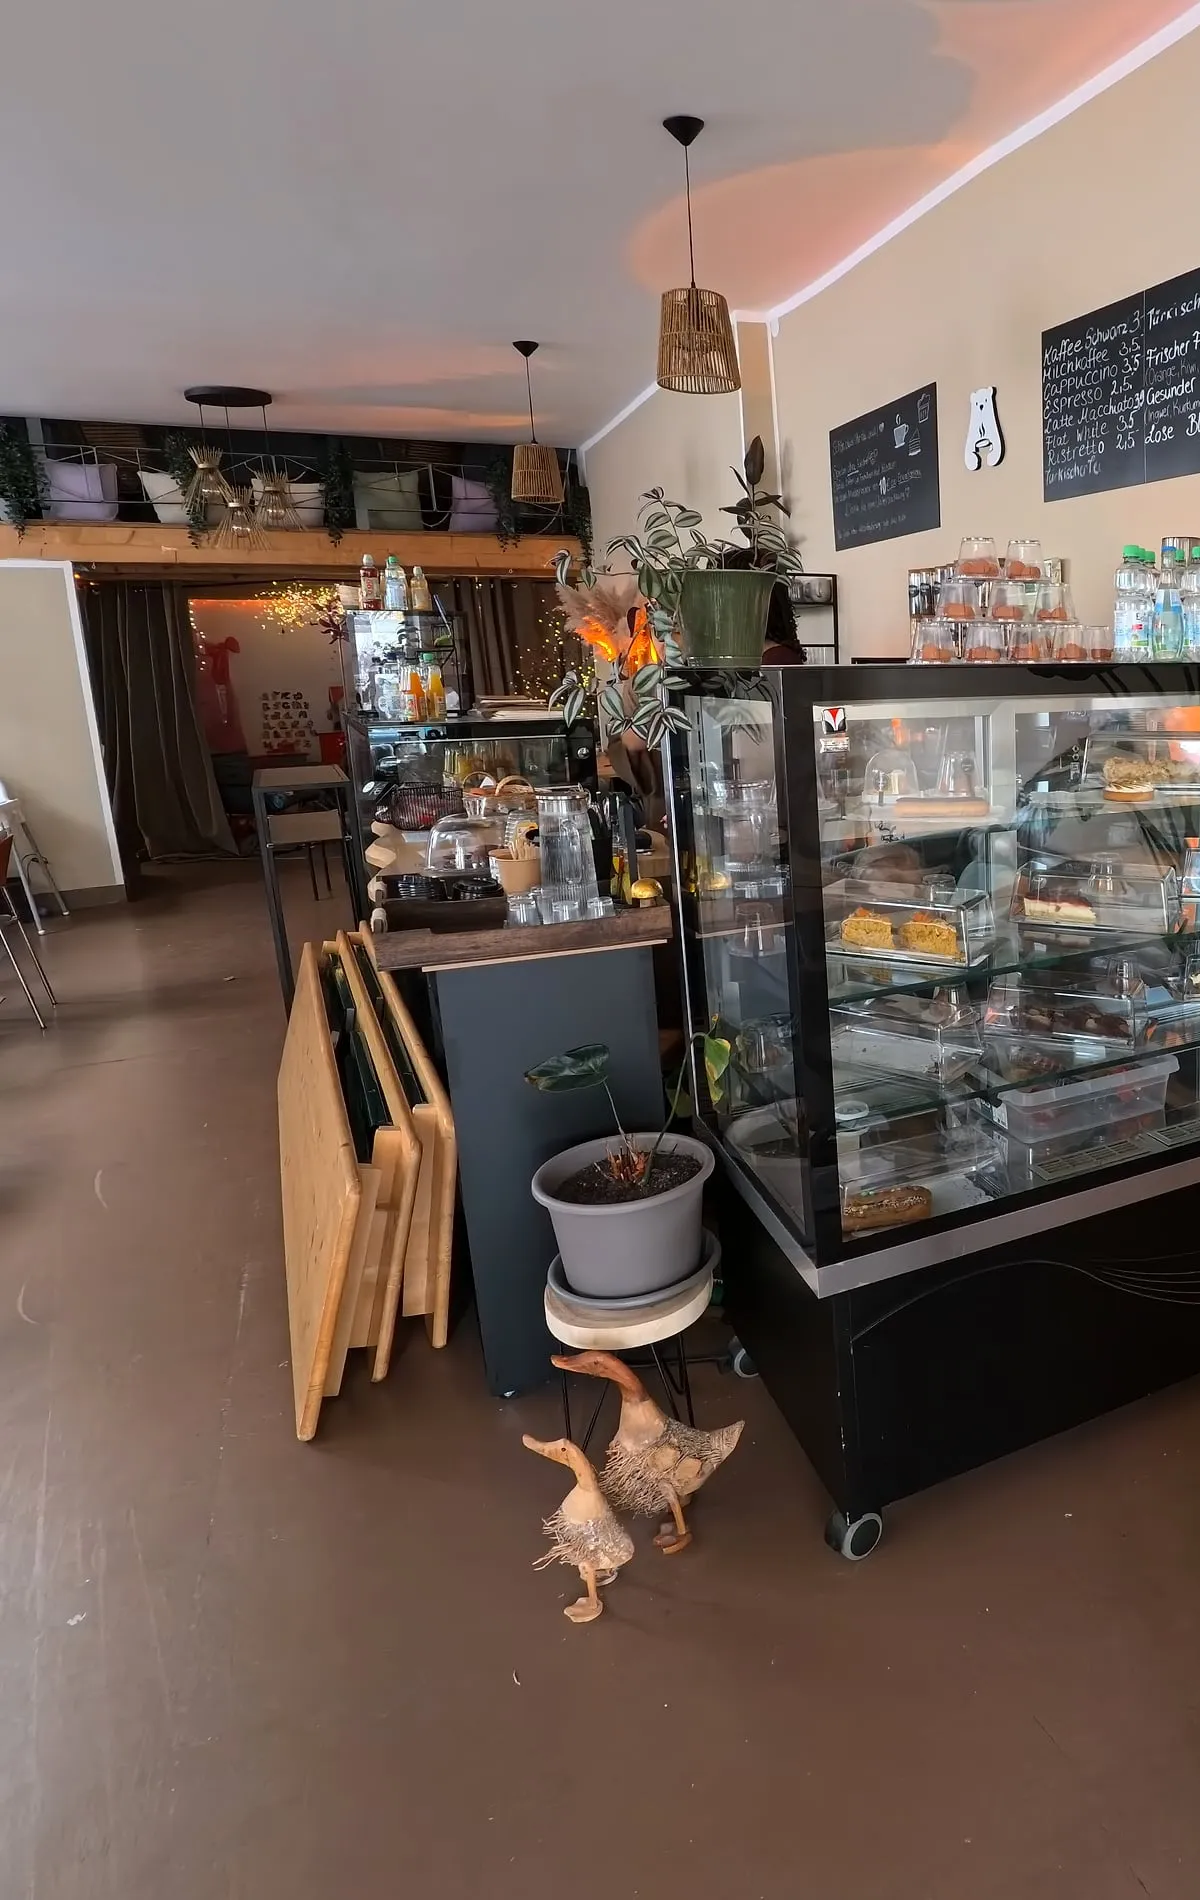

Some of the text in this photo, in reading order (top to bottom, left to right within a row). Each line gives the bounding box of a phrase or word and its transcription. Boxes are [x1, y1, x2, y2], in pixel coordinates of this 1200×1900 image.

[1043, 338, 1083, 367] Kaffee
[1085, 323, 1127, 349] Schwarz
[1146, 340, 1190, 369] Frischer
[1043, 347, 1109, 383] Milchkaffee
[1044, 364, 1118, 401] Cappuccino
[1146, 376, 1197, 406] Gesunder
[1043, 386, 1103, 420] Espresso
[1044, 413, 1074, 435] Latte
[1077, 394, 1133, 424] Macchiato
[1046, 431, 1069, 451] Flat
[1077, 420, 1109, 442] White
[1144, 423, 1175, 445] Lose
[1047, 440, 1104, 467] Ristretto
